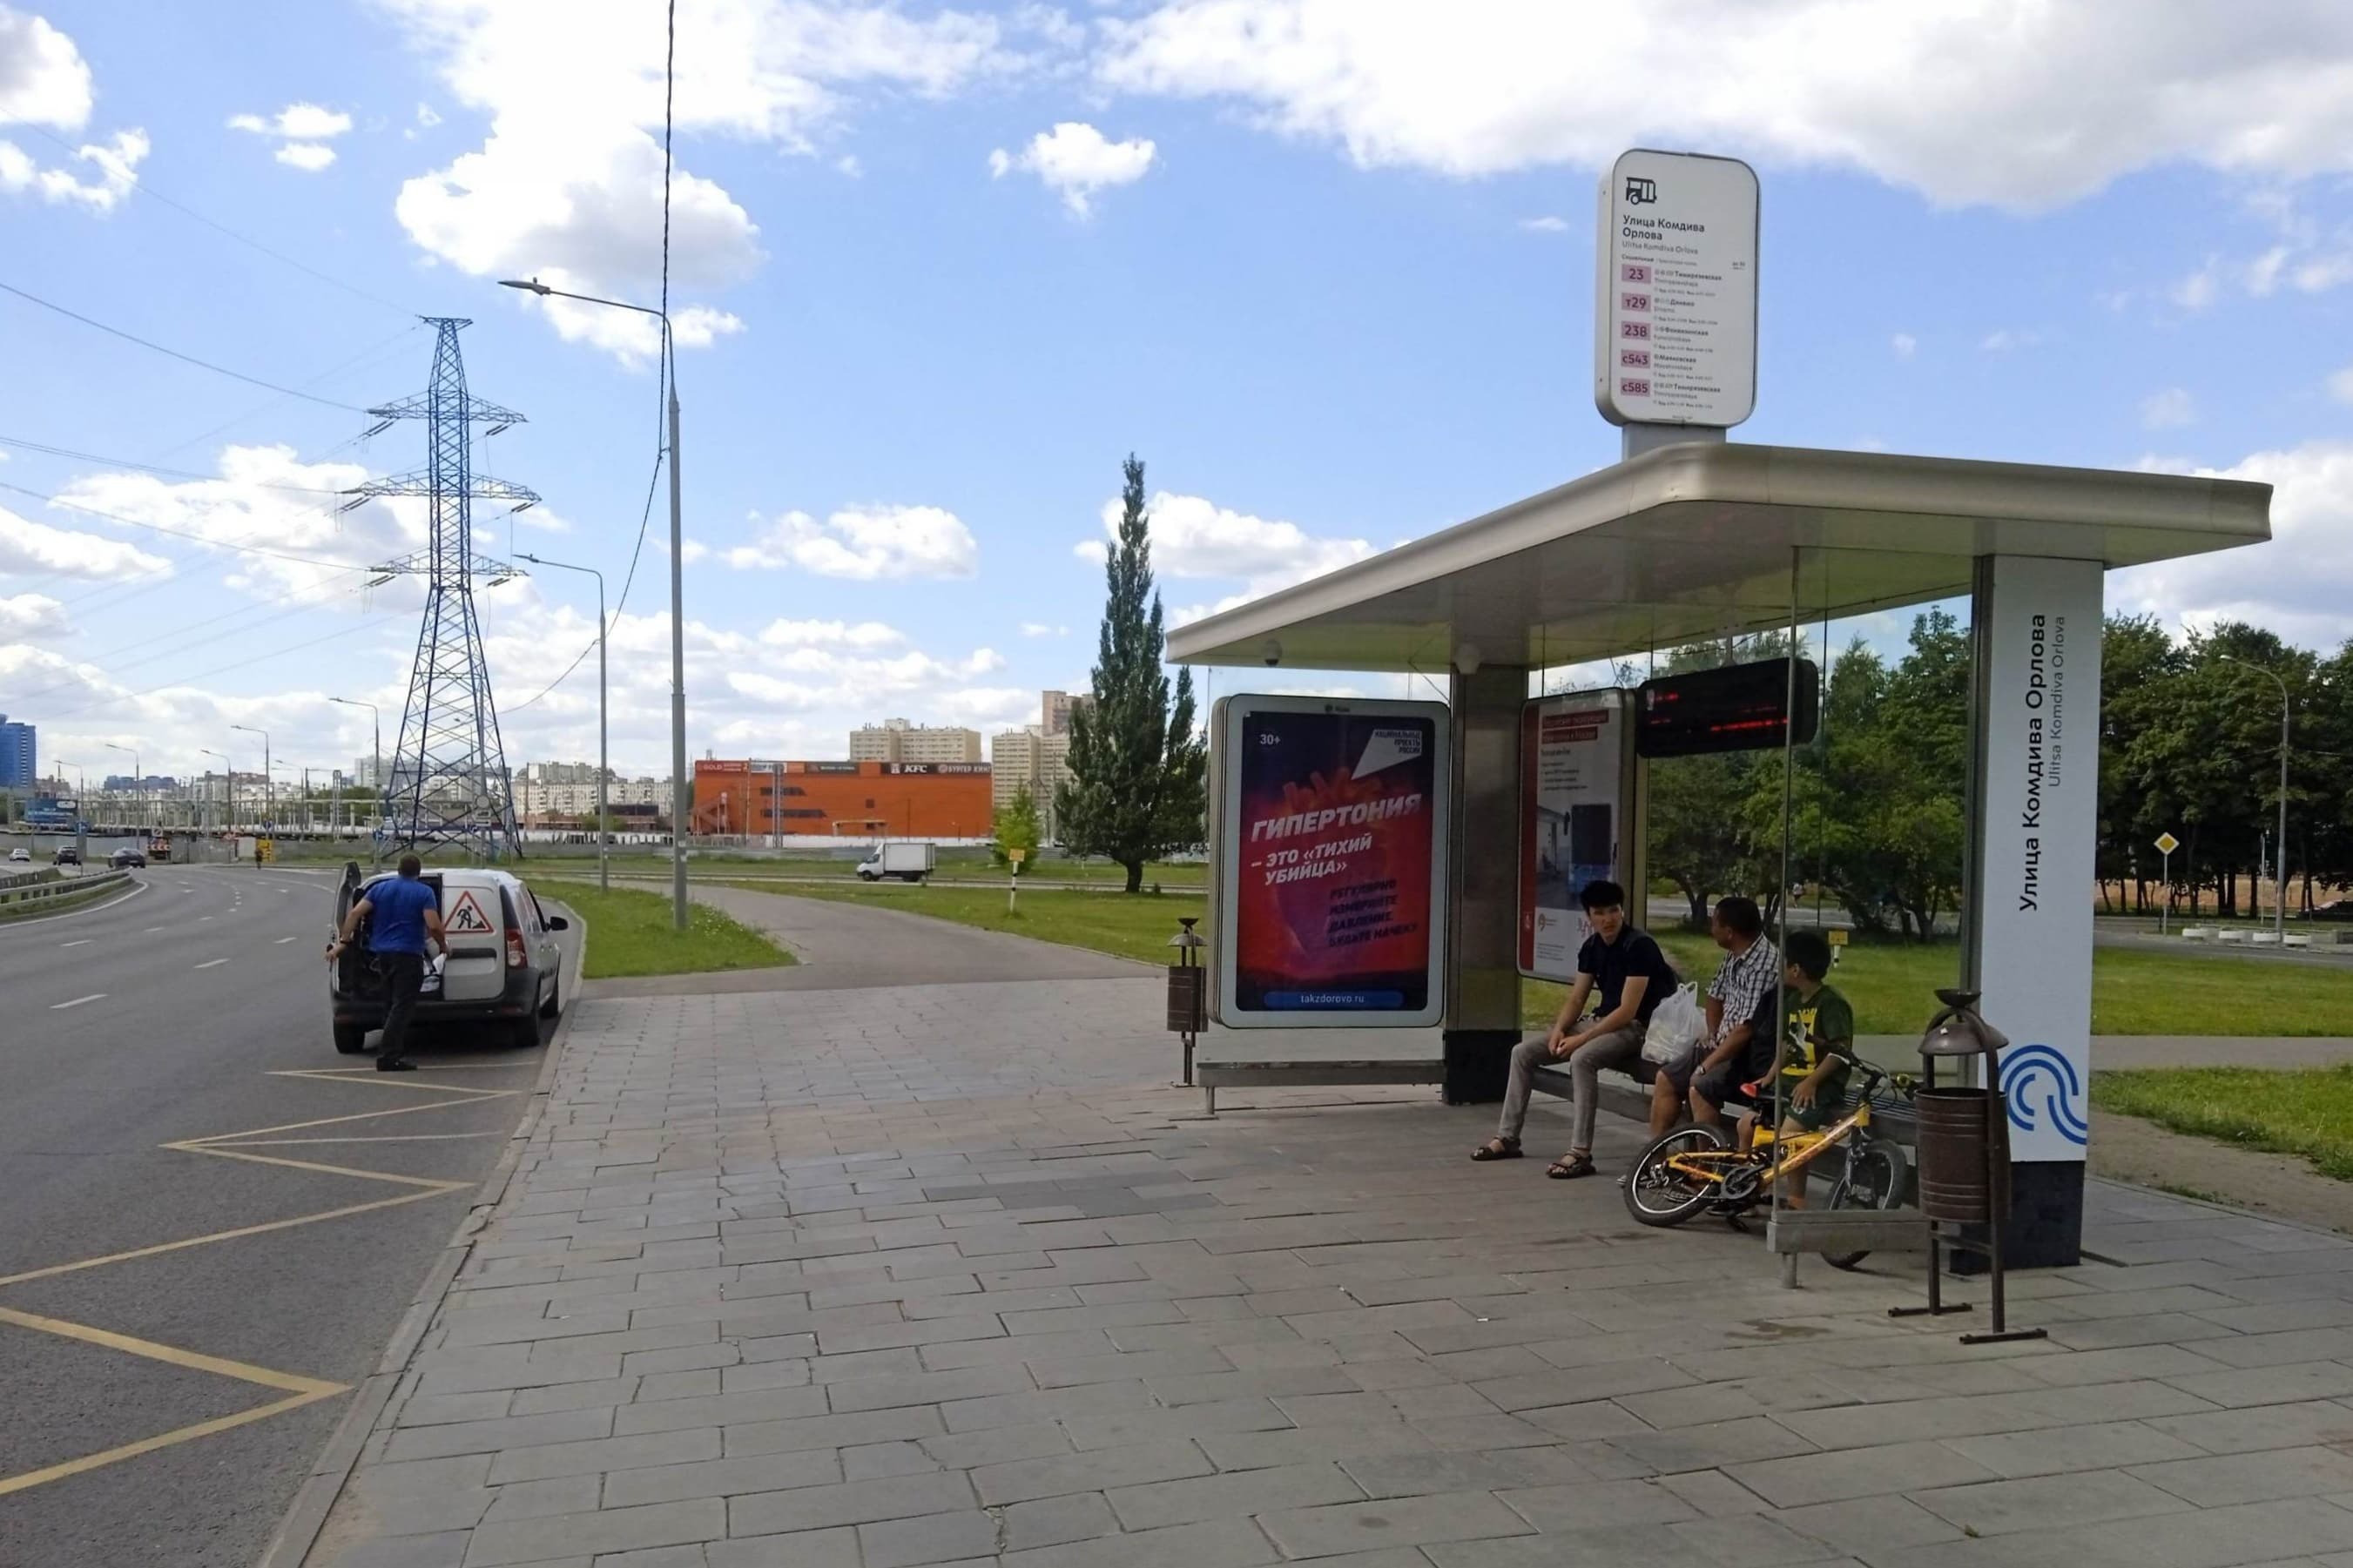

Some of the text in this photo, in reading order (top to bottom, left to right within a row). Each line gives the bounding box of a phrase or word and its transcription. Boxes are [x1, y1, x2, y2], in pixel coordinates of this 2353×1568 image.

[1622, 214, 1705, 232] Улица Комдива
[1622, 226, 1663, 240] Орлова
[1628, 268, 1644, 280] 23
[1625, 325, 1648, 338] 238
[2048, 616, 2065, 787] Ulitsa Komdiva Orlova
[1259, 733, 1281, 746] 30+
[904, 764, 927, 773] KFC
[2019, 614, 2046, 912] Улица Комдива Орлова
[1251, 793, 1422, 843] ГИПЕРТОНИЯ
[1265, 849, 1299, 868] ЭТО
[1303, 832, 1373, 860] «ТИХИЙ
[1264, 859, 1347, 886] УБИЙЦА»
